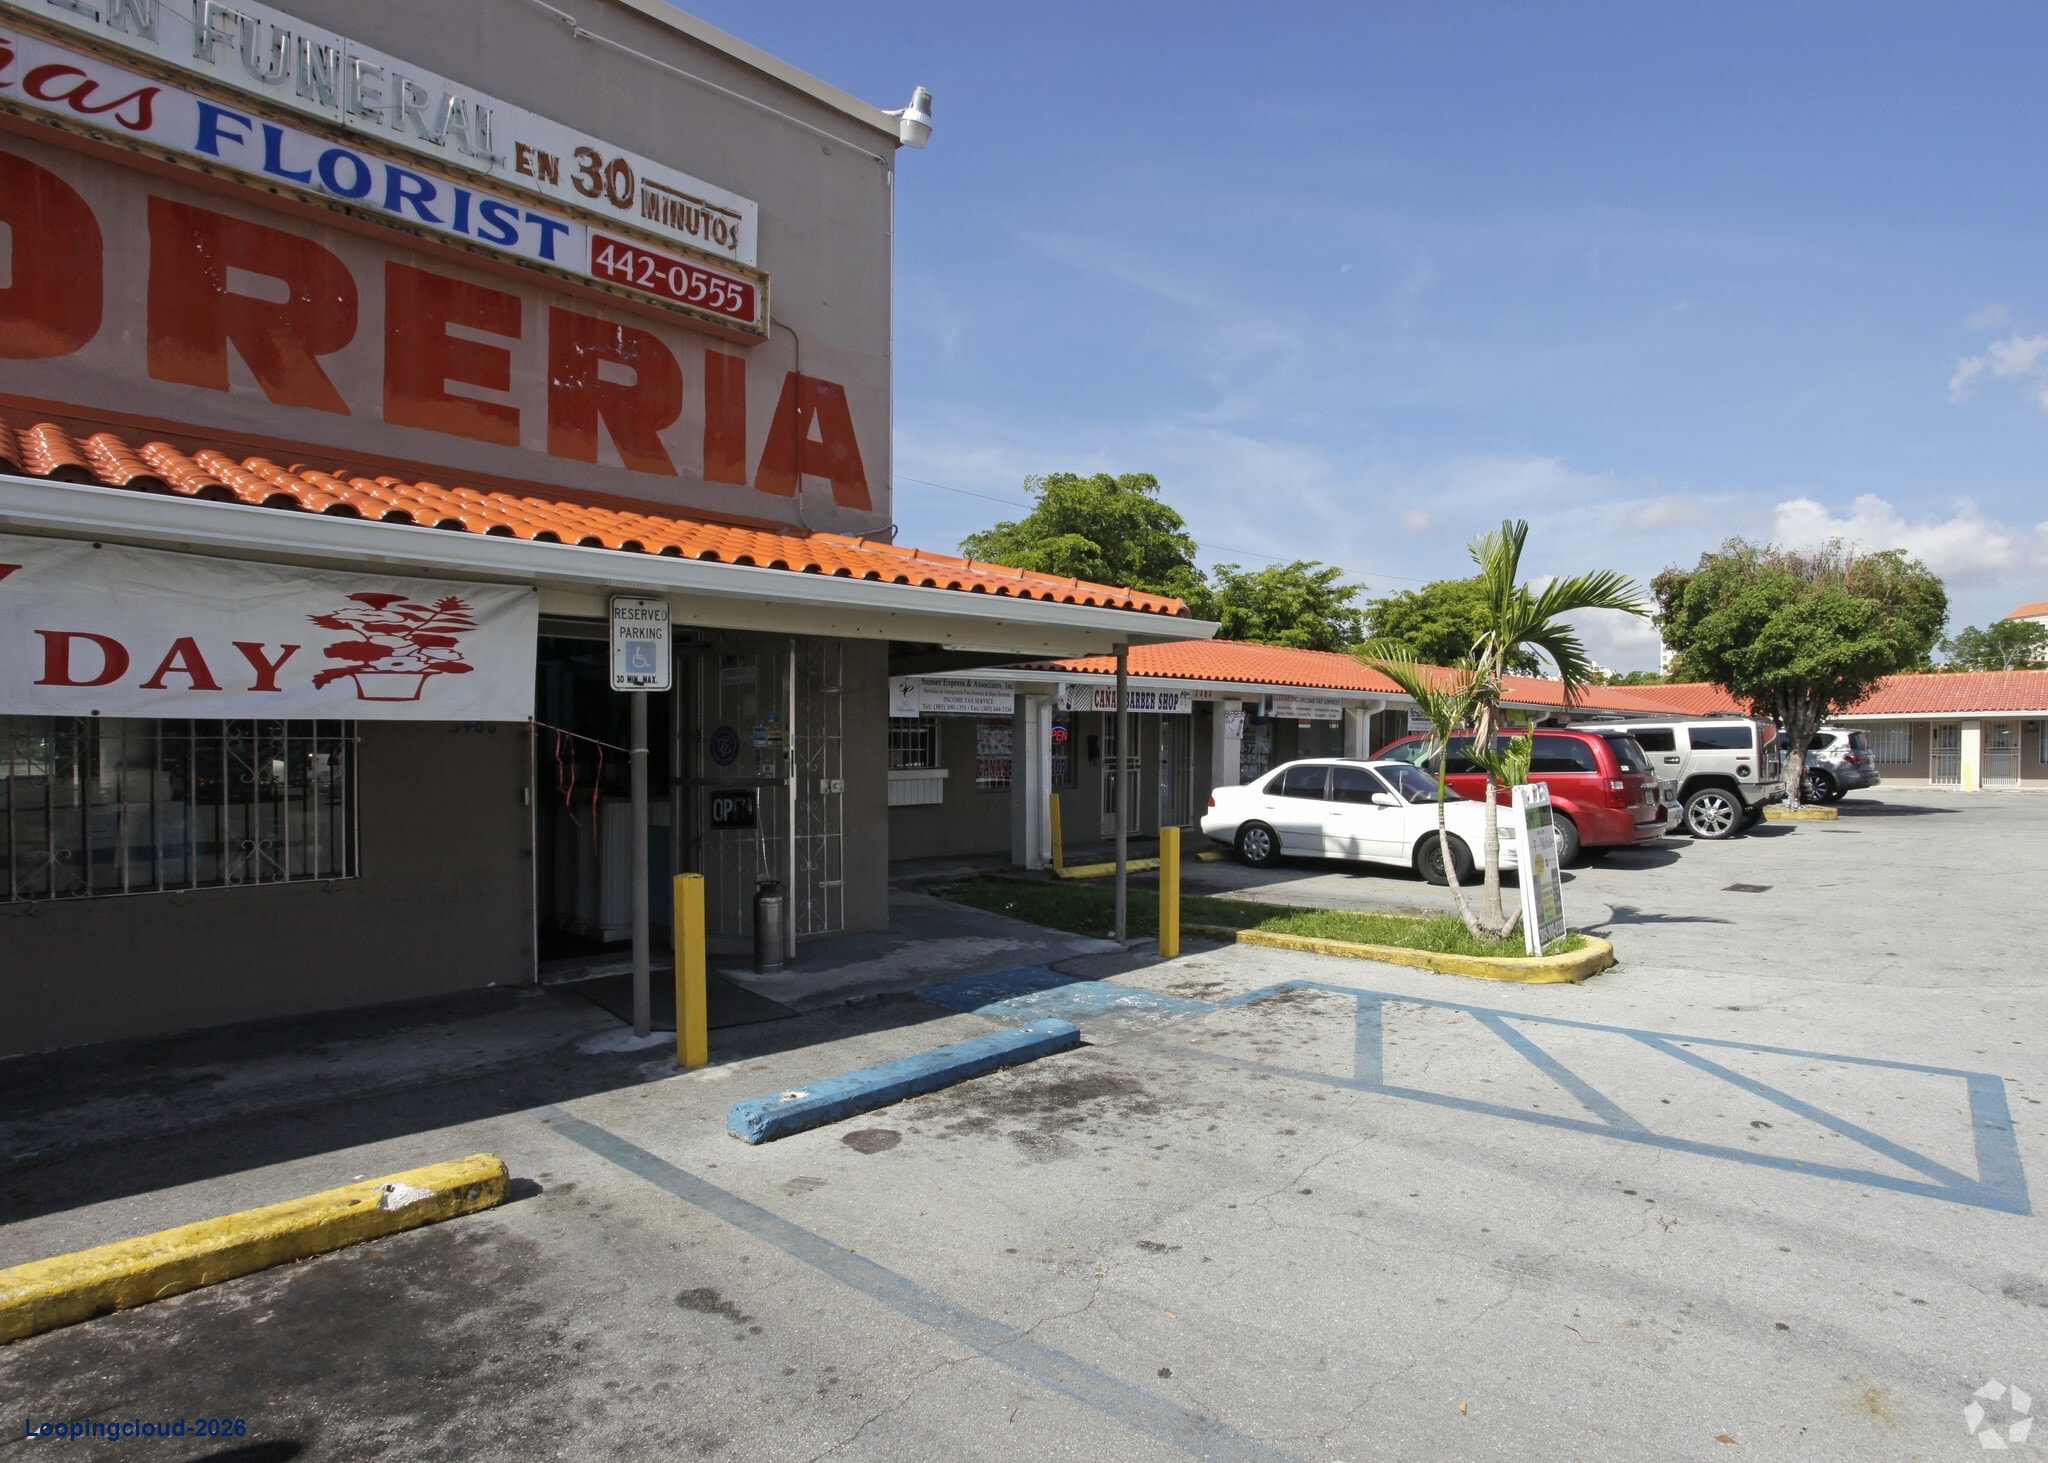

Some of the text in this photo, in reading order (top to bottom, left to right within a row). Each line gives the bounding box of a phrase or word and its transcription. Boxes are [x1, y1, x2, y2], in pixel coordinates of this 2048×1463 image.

[193, 0, 505, 169] FUNERAL
[515, 141, 559, 186] EN
[571, 146, 635, 210] 30
[641, 188, 741, 250] MINUTOS
[195, 101, 570, 261] FLORIST
[596, 244, 744, 313] 442-0555
[614, 608, 668, 622] RESERVED
[620, 626, 663, 640] PARKING
[33, 629, 302, 693] DAY
[616, 675, 625, 684] 30
[921, 677, 942, 686] Sunset
[943, 678, 966, 689] Express
[966, 679, 972, 688] &
[1094, 686, 1117, 709] CAÑA
[1158, 692, 1179, 711] SHOP
[1051, 730, 1069, 742] PEN
